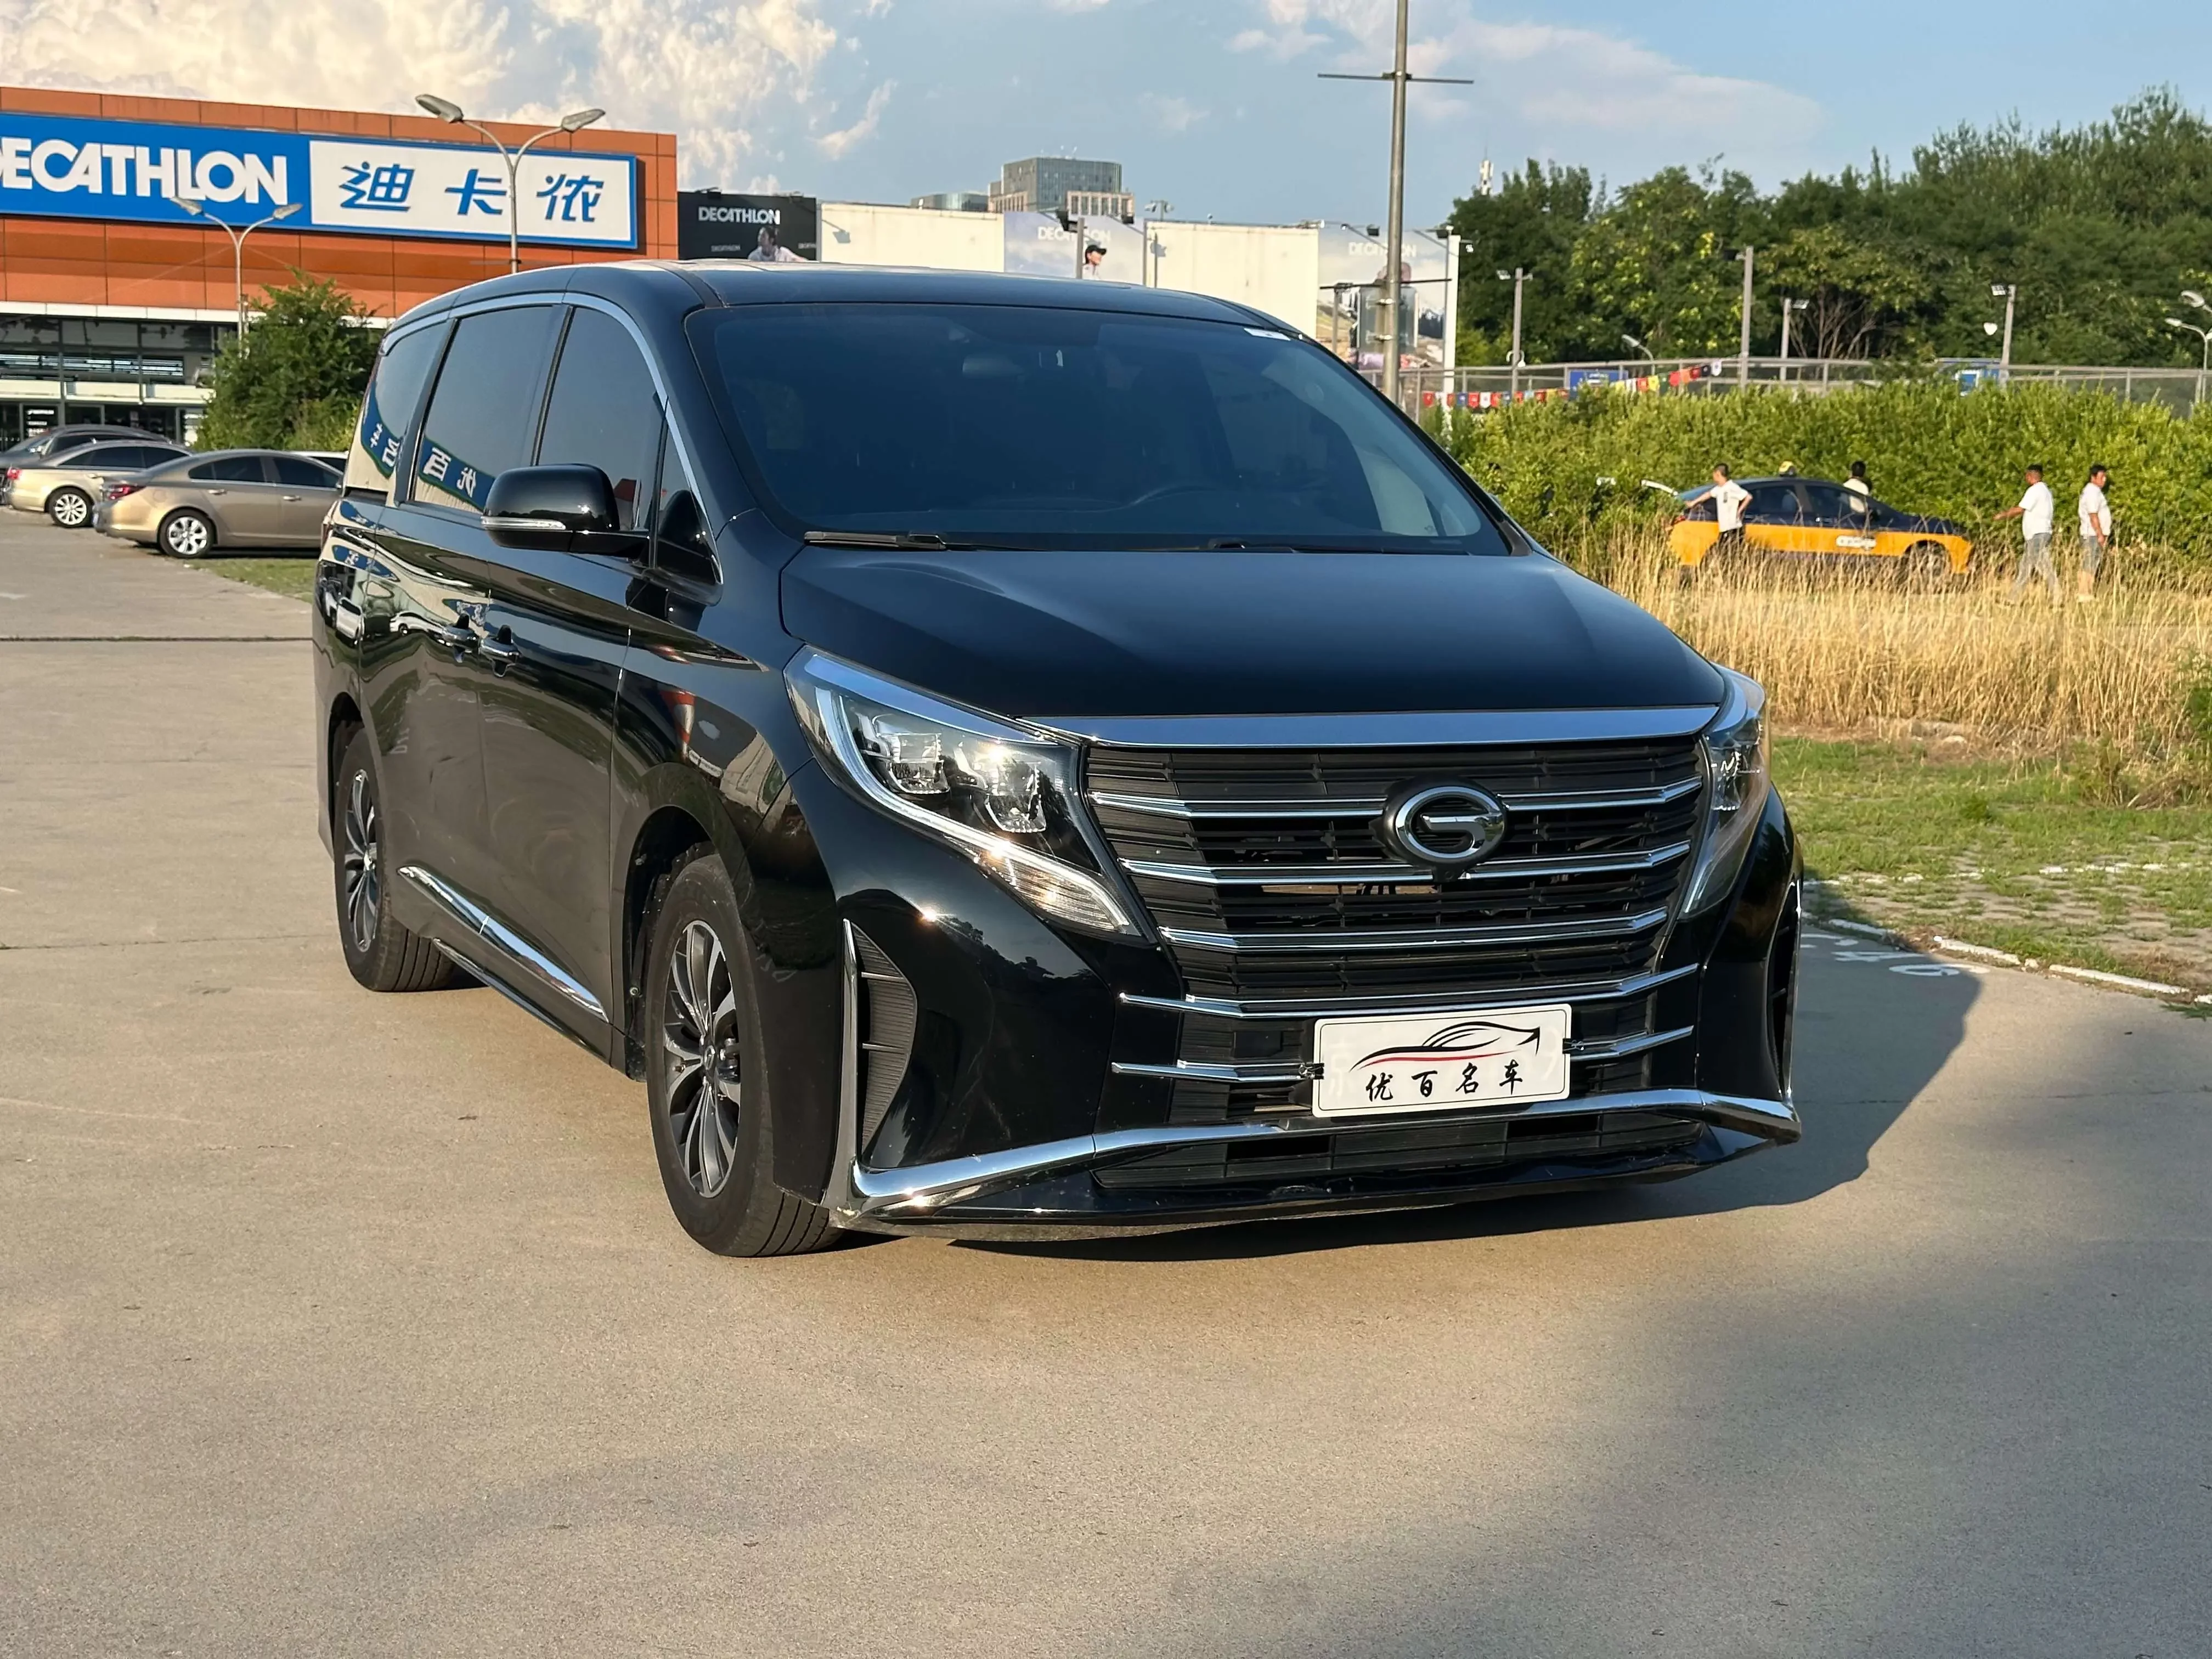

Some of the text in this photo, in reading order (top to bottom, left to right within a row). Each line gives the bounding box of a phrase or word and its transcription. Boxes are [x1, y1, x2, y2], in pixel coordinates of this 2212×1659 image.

[0, 137, 287, 205] ECATHLON
[338, 160, 605, 222] 迪卡侬
[698, 206, 780, 225] DECATHLON
[1365, 1059, 1523, 1102] 优百名车
